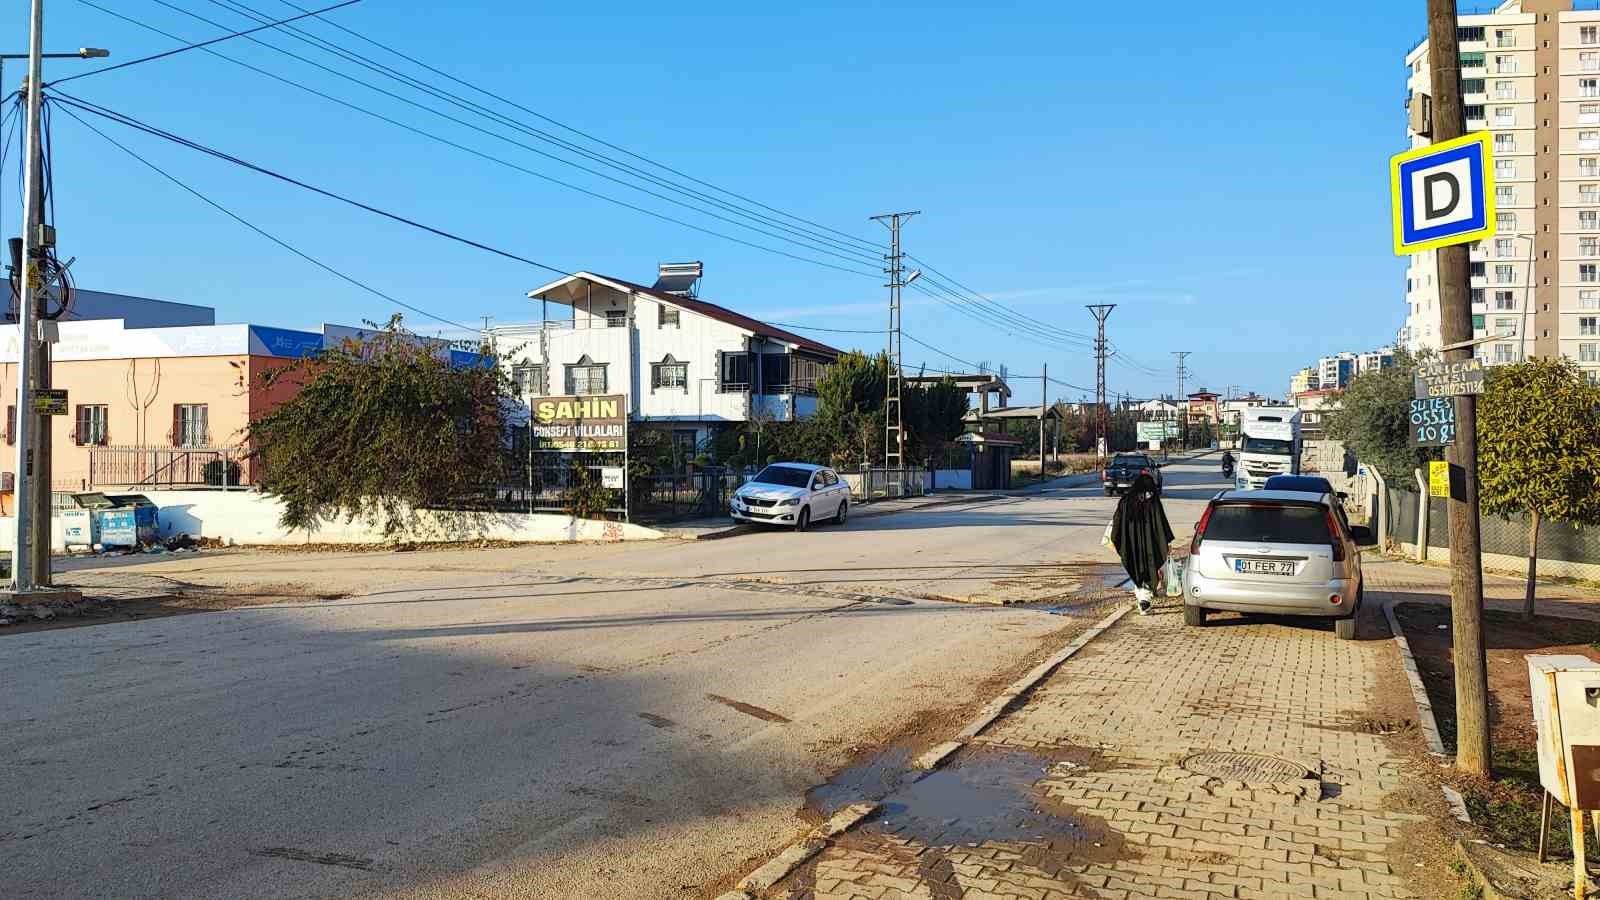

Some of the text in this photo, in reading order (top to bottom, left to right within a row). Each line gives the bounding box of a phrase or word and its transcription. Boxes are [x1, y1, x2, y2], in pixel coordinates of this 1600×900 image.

[1424, 171, 1460, 221] D
[538, 398, 617, 424] ŞAHİN
[574, 423, 623, 437] VİLLALARI
[1241, 561, 1251, 570] 01
[1255, 561, 1276, 571] FER
